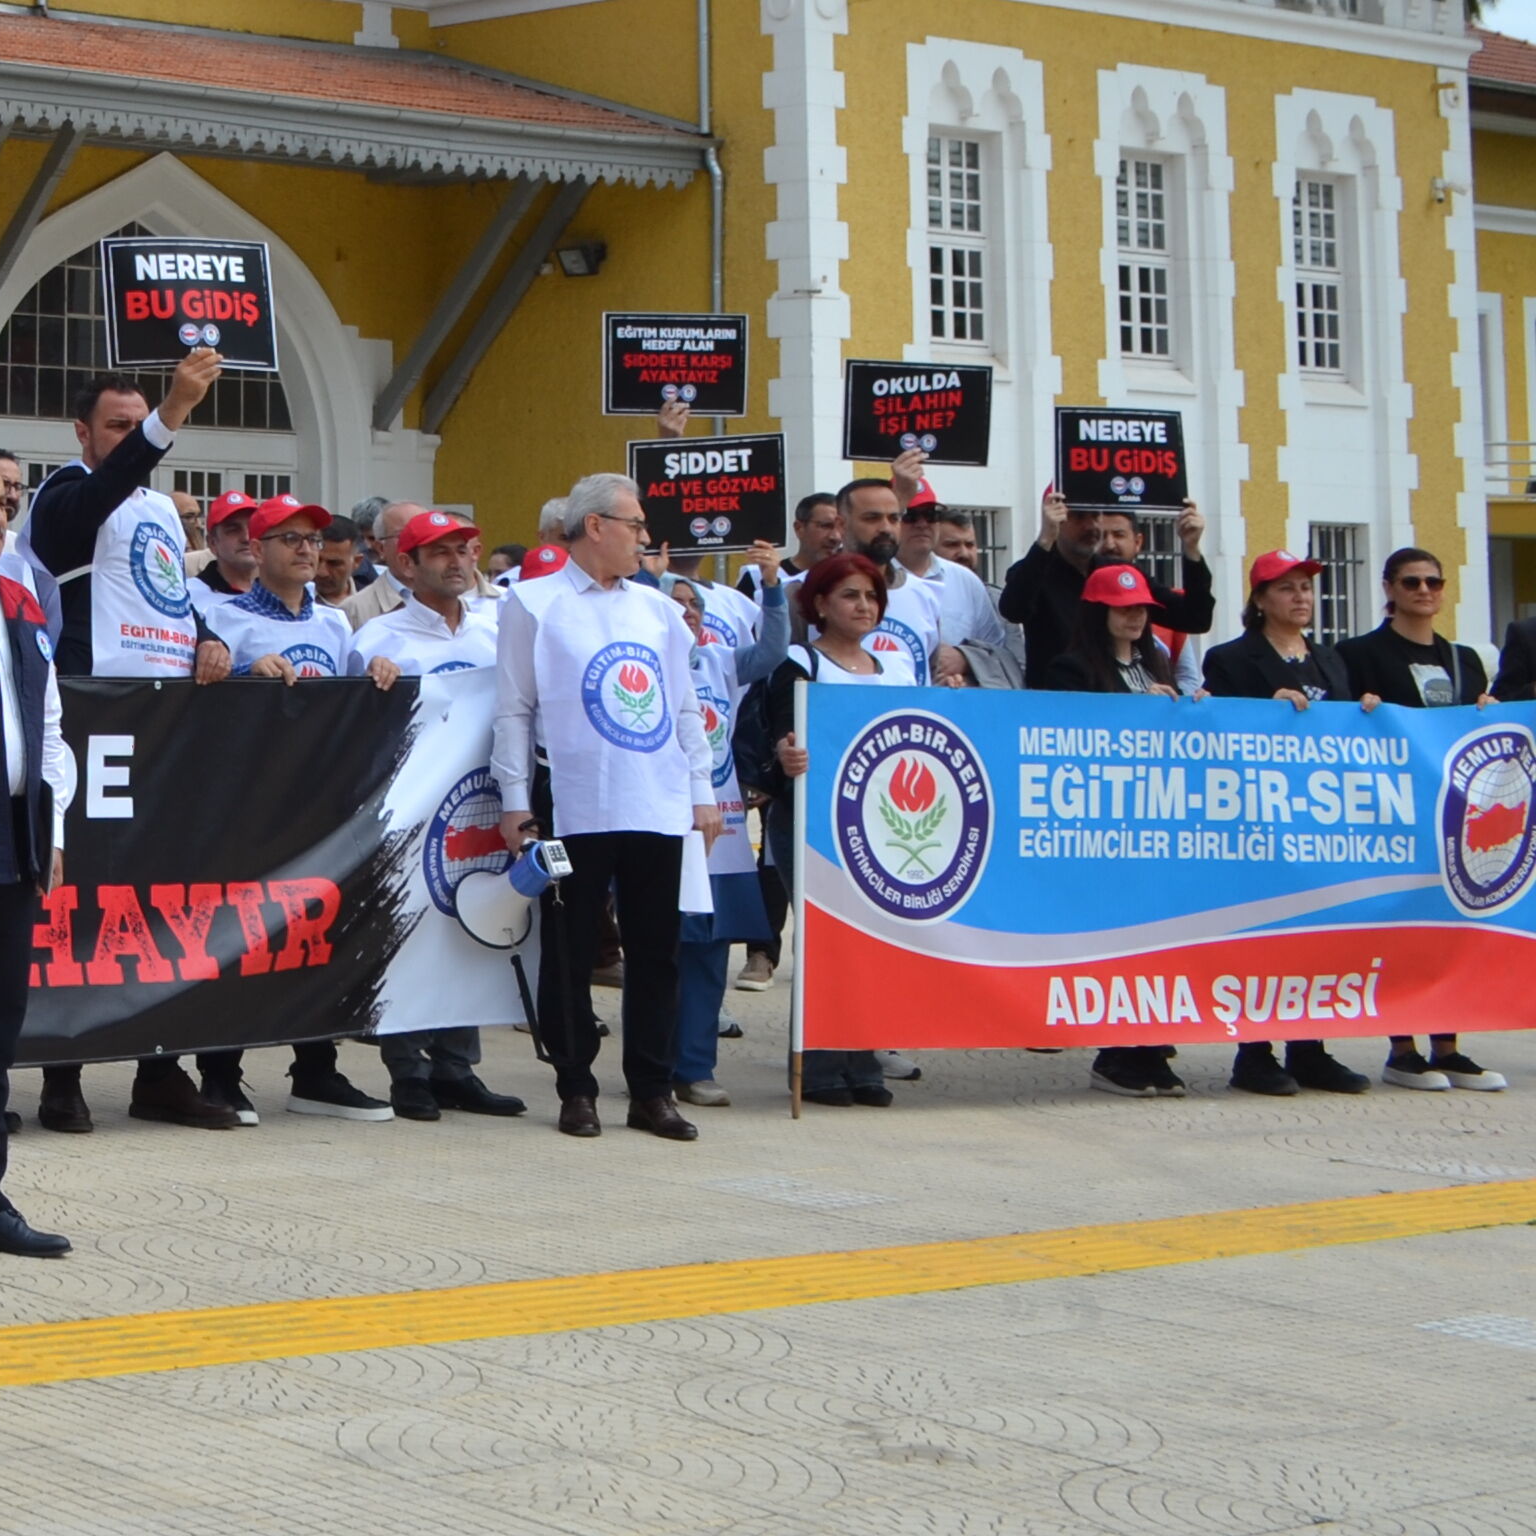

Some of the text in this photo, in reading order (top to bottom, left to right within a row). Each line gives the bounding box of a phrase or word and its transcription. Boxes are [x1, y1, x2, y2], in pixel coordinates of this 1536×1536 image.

[134, 253, 246, 283] NEREYE
[125, 289, 261, 327] BU GİDİŞ
[616, 325, 737, 340] EĞİTİM KURUMLARINI
[642, 339, 714, 351] HEDEF ALAN
[623, 353, 733, 369] ŞİDDETE KARŞI
[639, 370, 719, 384] AYAKTAYIZ
[872, 371, 962, 396] OKULDA
[873, 389, 963, 415] SİLAHIN
[879, 411, 956, 435] İŞİ NE?
[1078, 419, 1167, 444] NEREYE
[664, 448, 753, 479] ŞİDDET
[1070, 447, 1178, 479] BU GİDİŞ
[647, 475, 776, 498] ACI VE GÖZYAŞI
[682, 496, 740, 513] DEMEK
[1019, 726, 1409, 765] MEMUR-SEN KONFEDERASYONU
[842, 723, 984, 804] EĞİTİM-BİR-SEN
[1019, 763, 1416, 825] EĞİTİM-BİR-SEN
[1019, 827, 1416, 864] EĞİTİMCİLER BİRLİĞİ SENDİKASI
[846, 825, 980, 909] EĞİTİMCİLER BİRLİĞİ SENDİKASI
[29, 876, 342, 988] HAYIR
[1046, 957, 1382, 1036] ADANA ŞUBESİ
